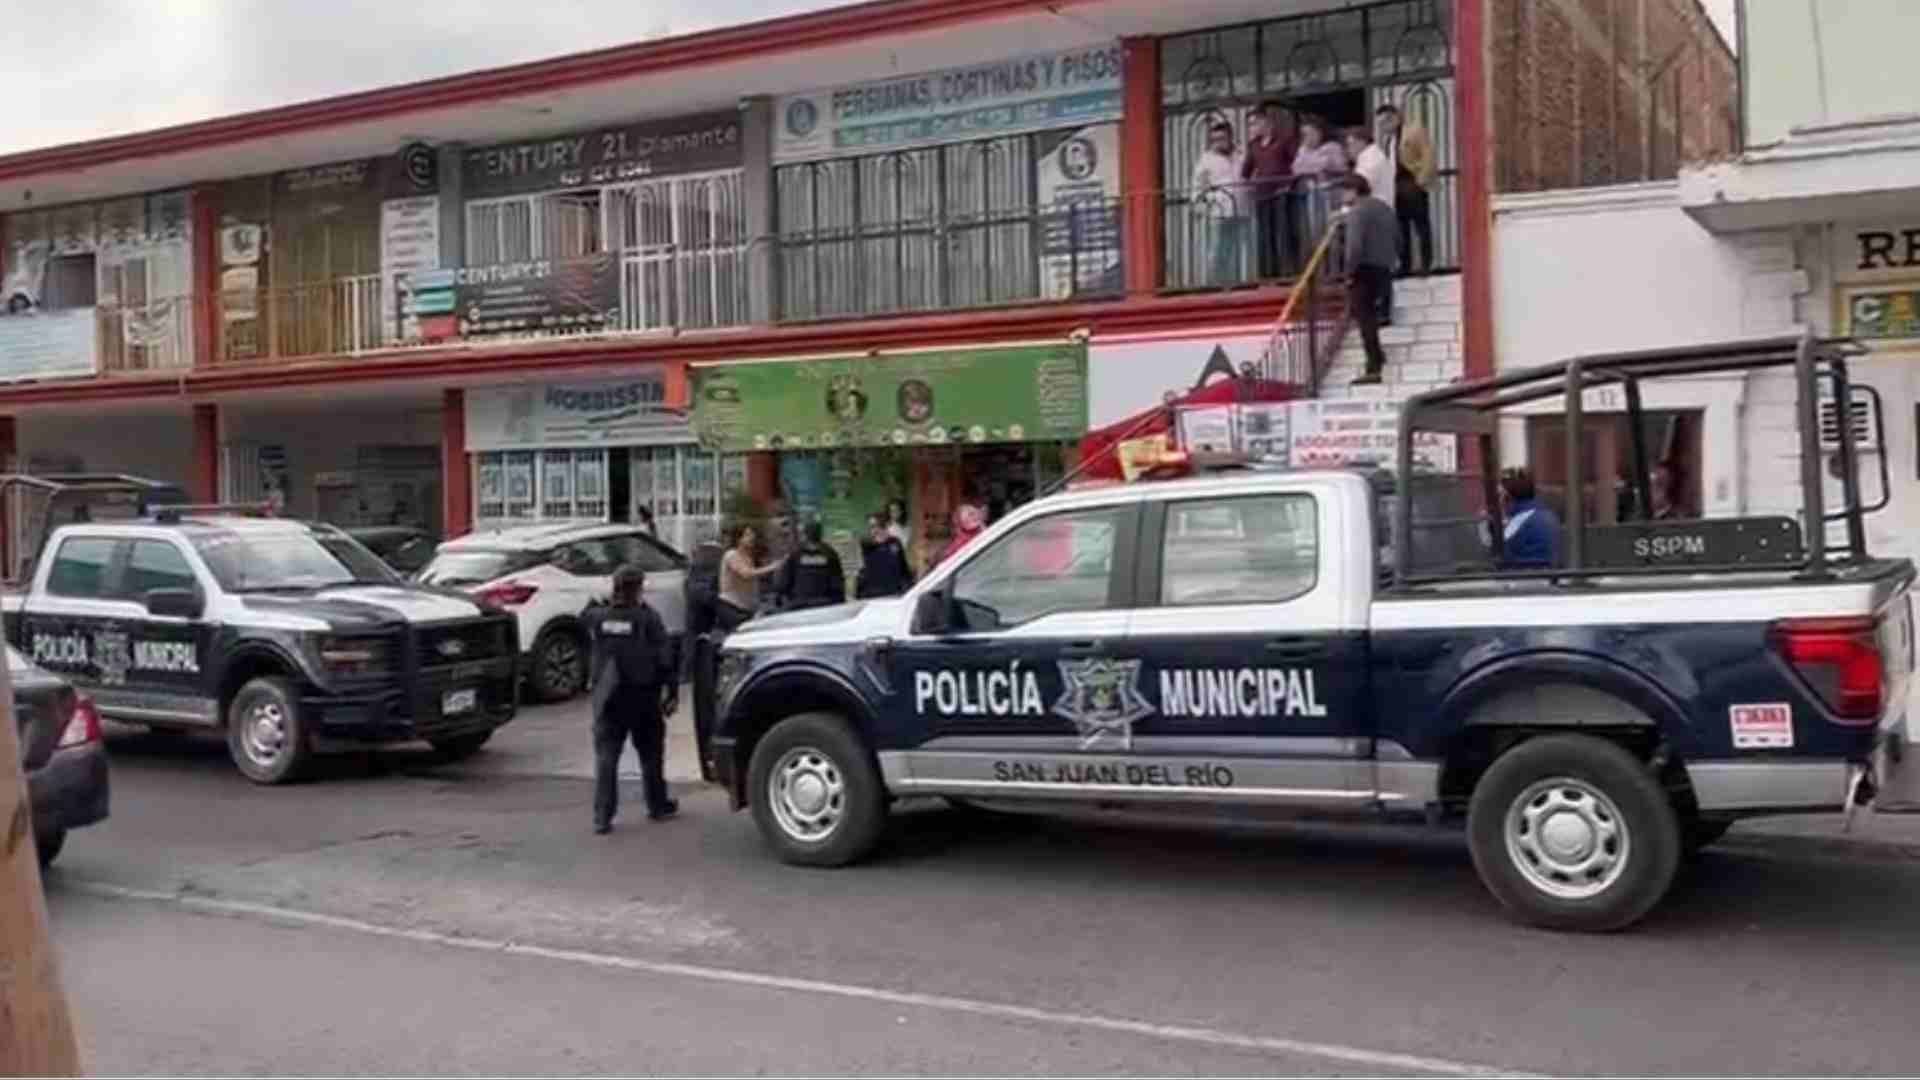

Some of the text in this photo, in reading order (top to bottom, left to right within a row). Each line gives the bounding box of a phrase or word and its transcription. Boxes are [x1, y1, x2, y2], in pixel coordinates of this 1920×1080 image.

[1633, 535, 1705, 556] SSPM
[33, 629, 200, 673] POLICÍA MUNICIPAL
[914, 659, 1328, 717] POLICÍA MUNICIPAL
[993, 760, 1235, 788] SAN JUAN DEL RÍO
